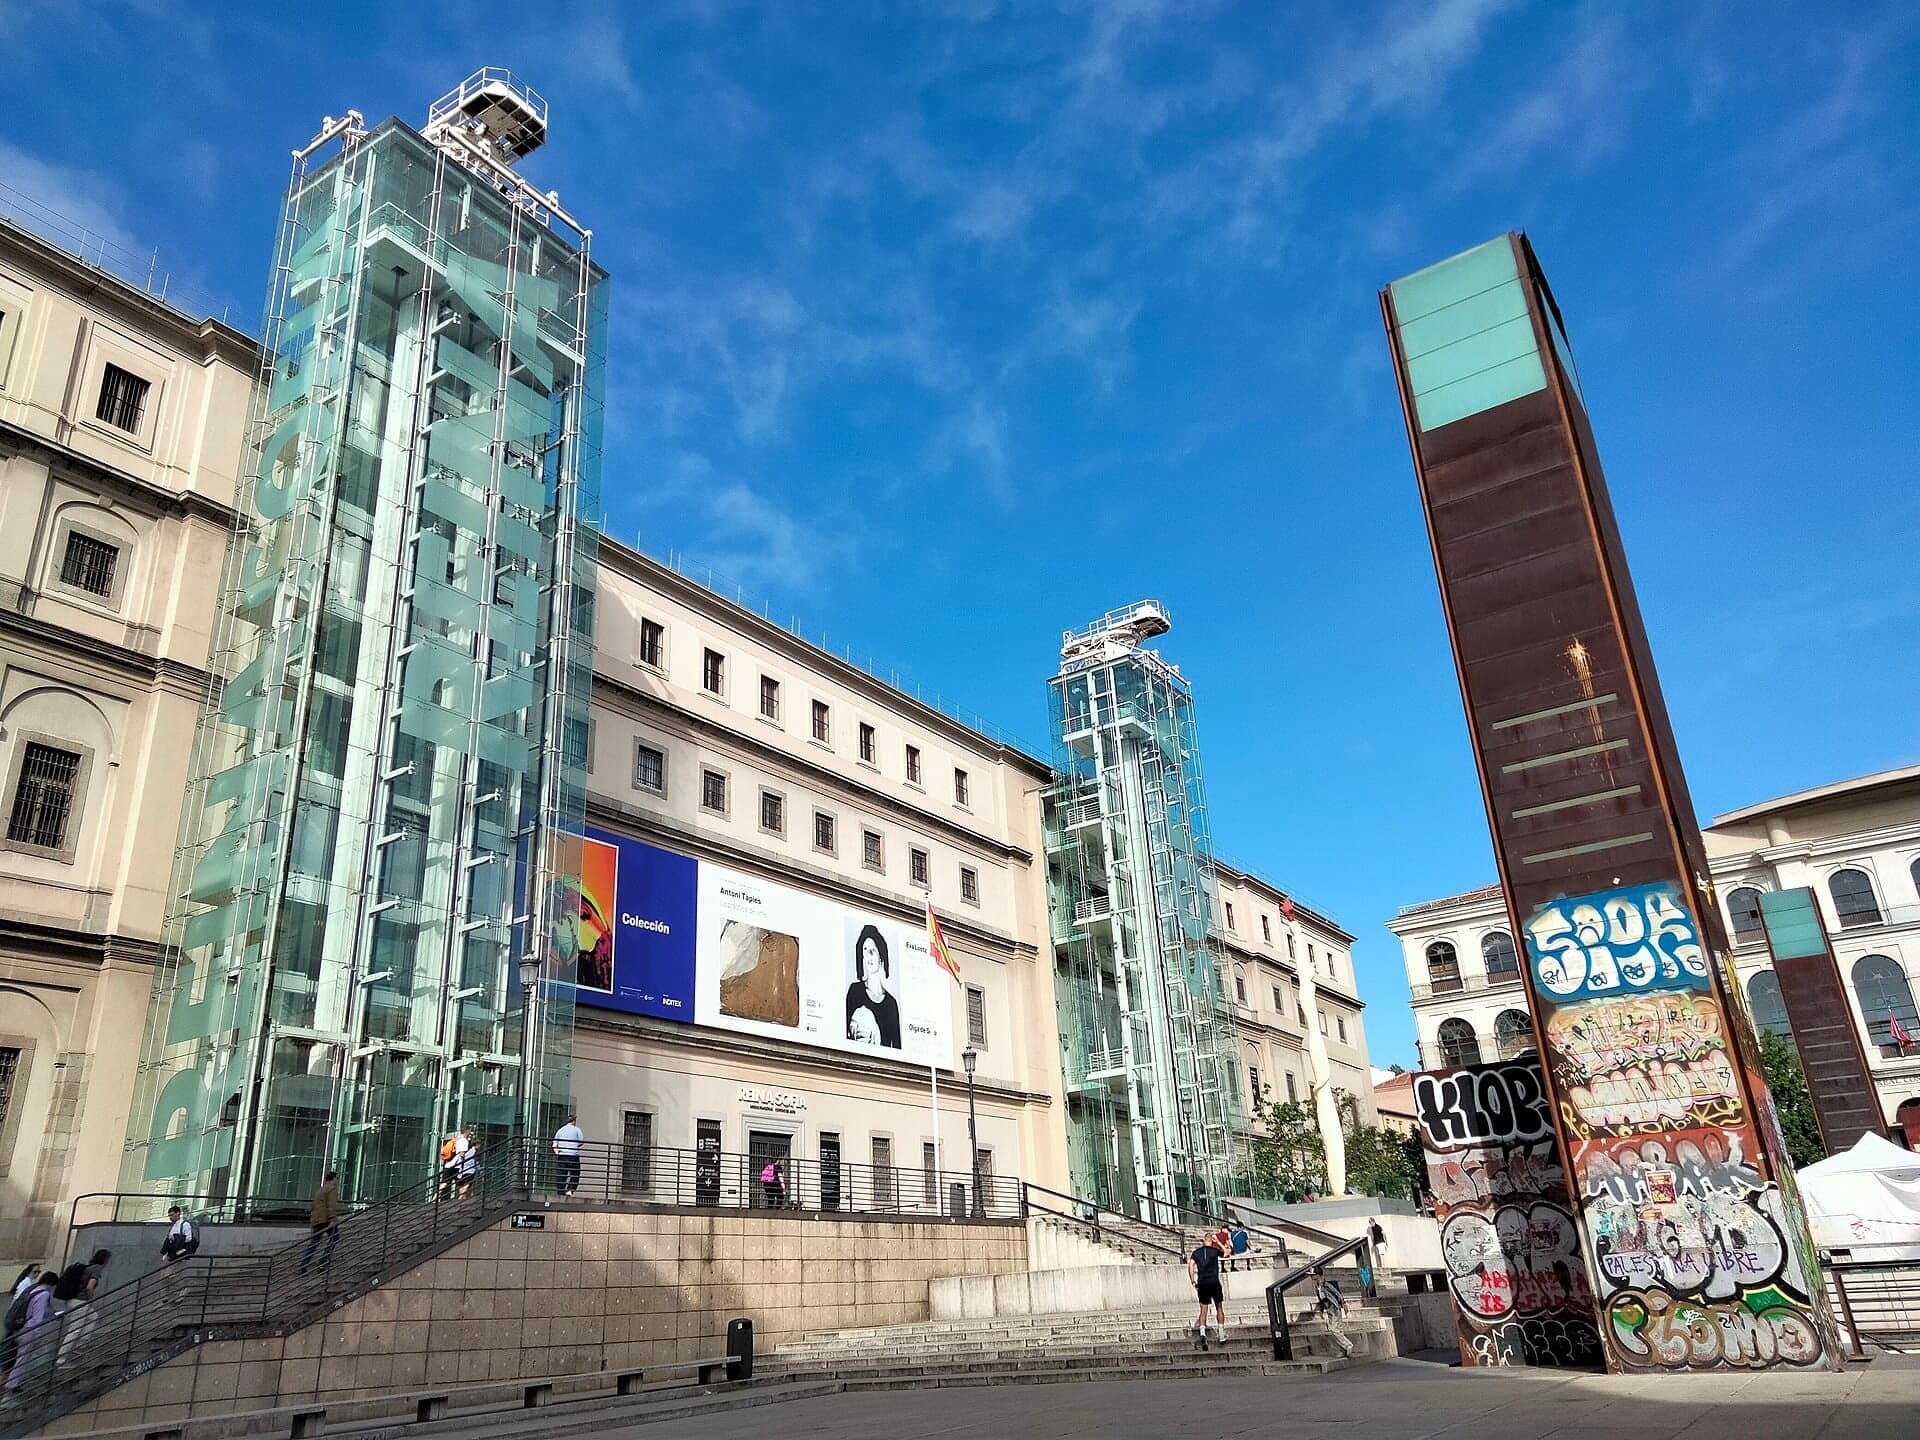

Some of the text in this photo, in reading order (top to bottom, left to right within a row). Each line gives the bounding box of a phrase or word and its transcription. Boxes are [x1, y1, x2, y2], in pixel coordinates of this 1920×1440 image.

[400, 249, 559, 774] REINA
[720, 886, 741, 899] Antoni
[622, 913, 670, 934] Colección
